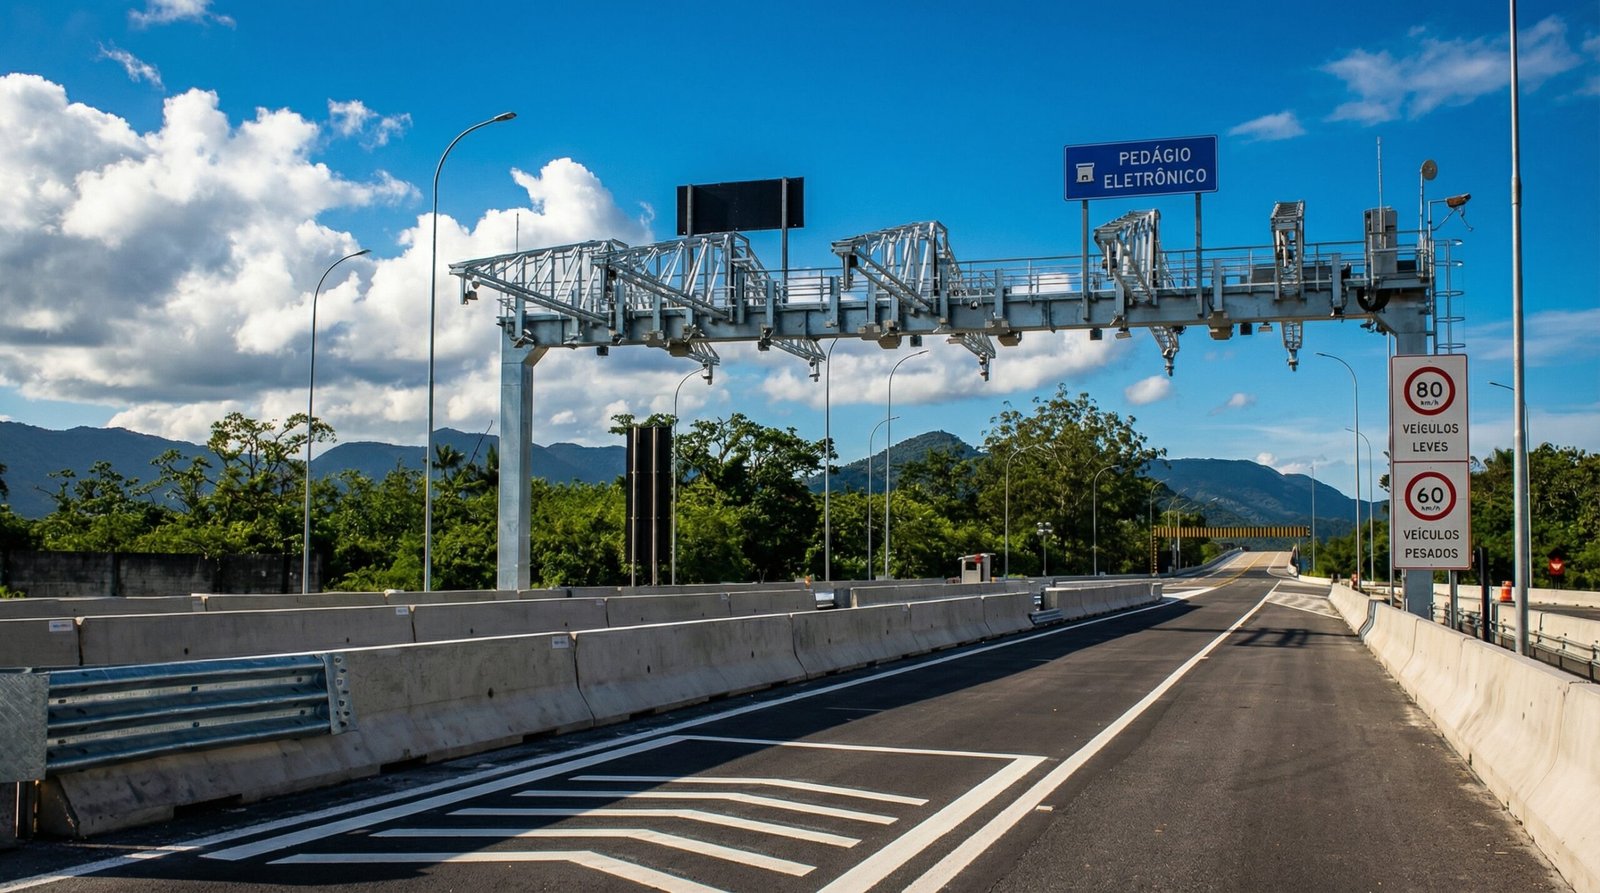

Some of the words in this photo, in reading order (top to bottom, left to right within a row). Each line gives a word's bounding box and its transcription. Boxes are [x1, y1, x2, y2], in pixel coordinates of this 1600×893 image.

[1119, 146, 1191, 166] PEDÁGIO
[1104, 167, 1207, 189] ELETRÔNICO
[1416, 381, 1443, 398] 80
[1403, 422, 1459, 434] VEÍCULOS
[1412, 442, 1448, 452] LEVES
[1417, 487, 1444, 504] 60
[1403, 527, 1460, 540] VEÍCULOS
[1405, 548, 1459, 559] PESADOS
